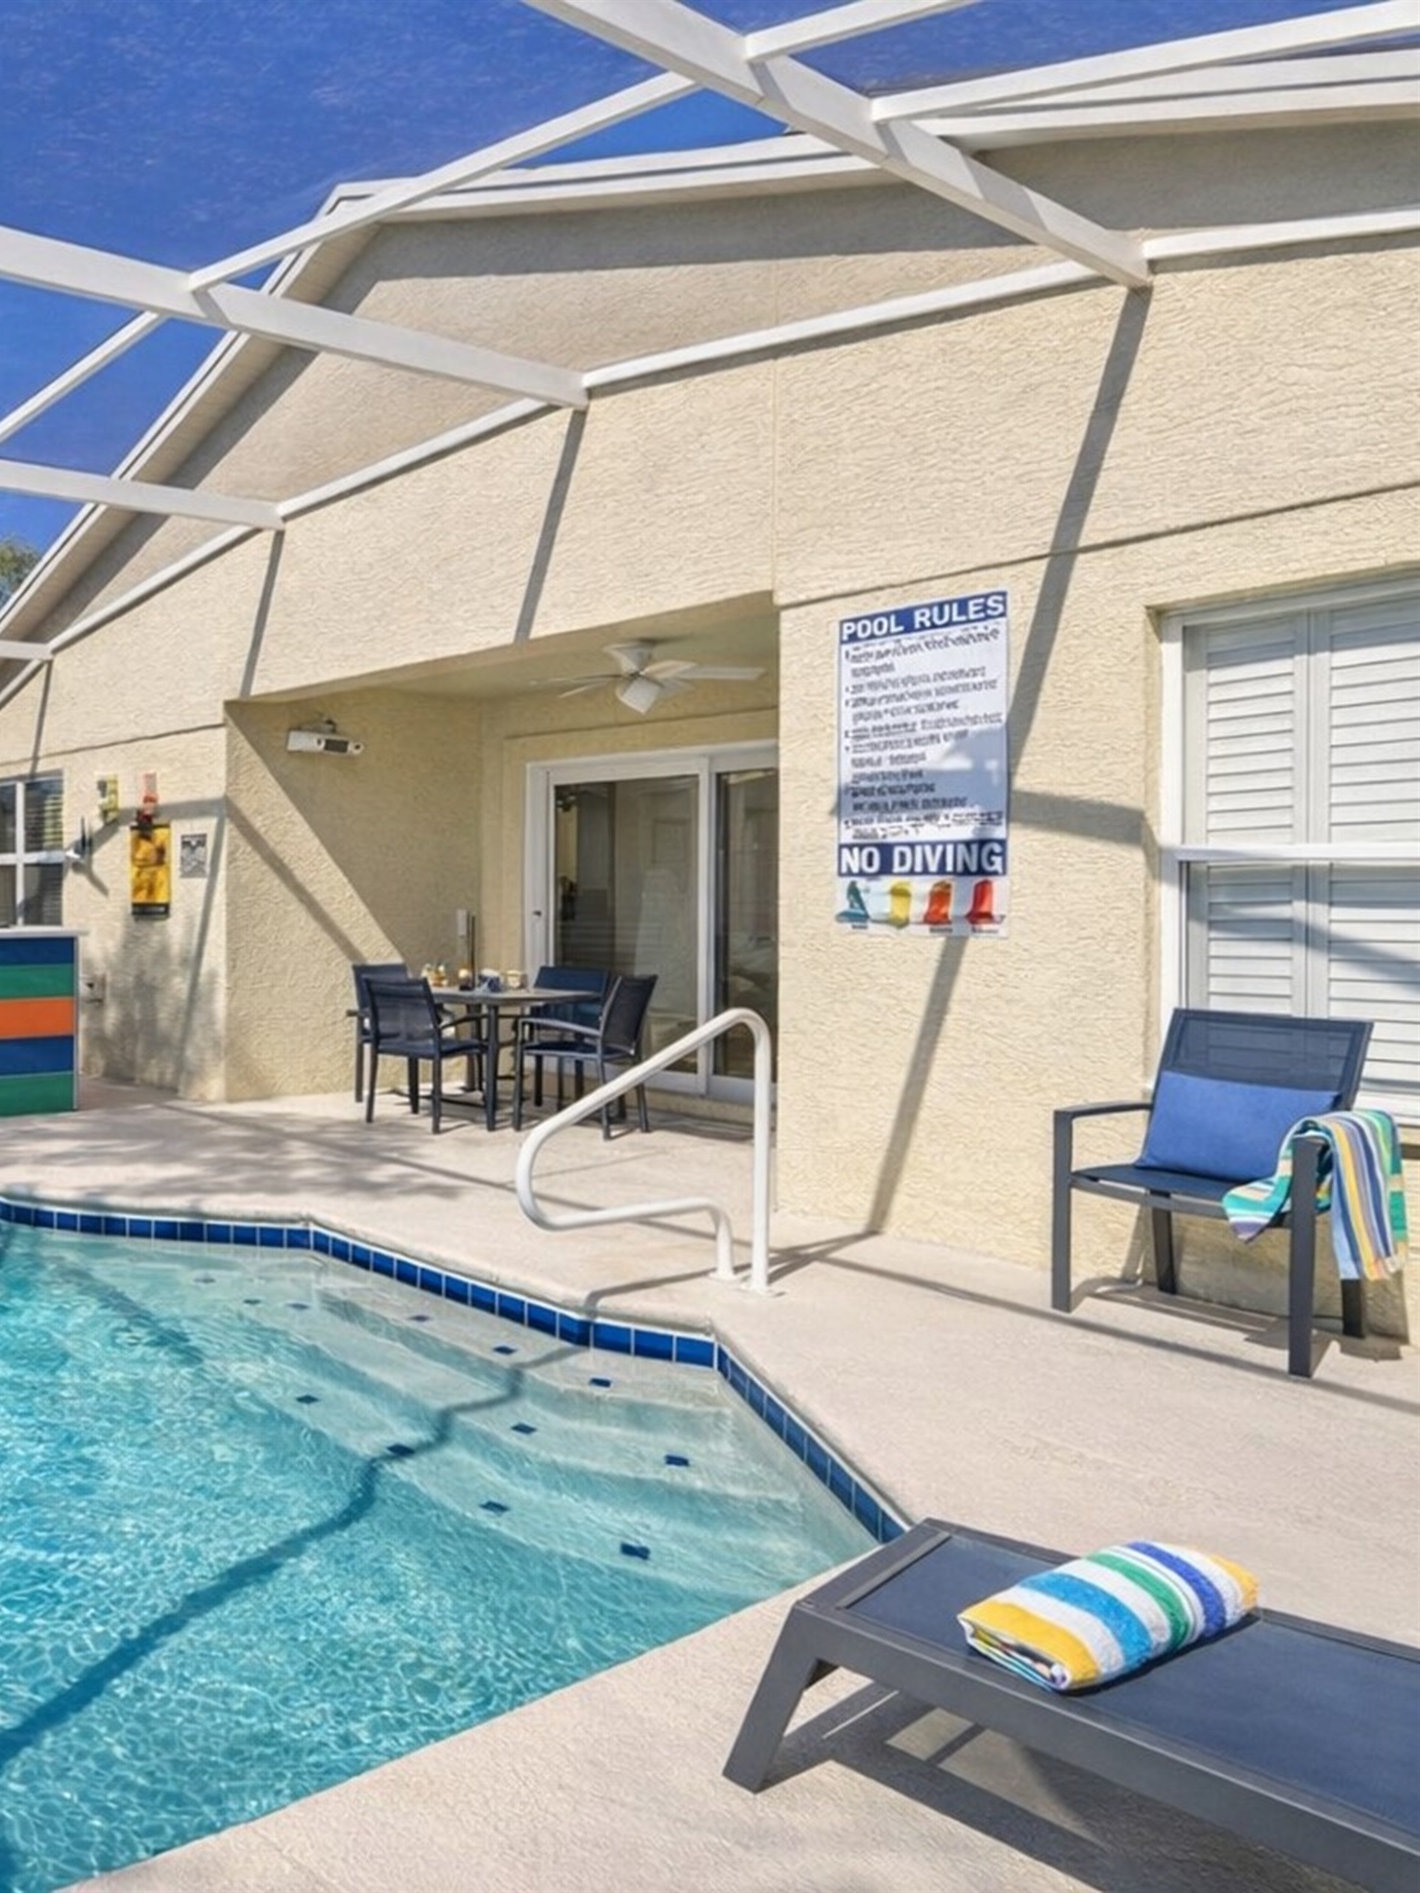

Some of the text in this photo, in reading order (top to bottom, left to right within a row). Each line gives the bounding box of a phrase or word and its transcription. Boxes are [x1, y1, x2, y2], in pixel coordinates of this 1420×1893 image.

[842, 595, 1004, 641] POOL RULES
[841, 842, 1003, 874] NO DIVING
